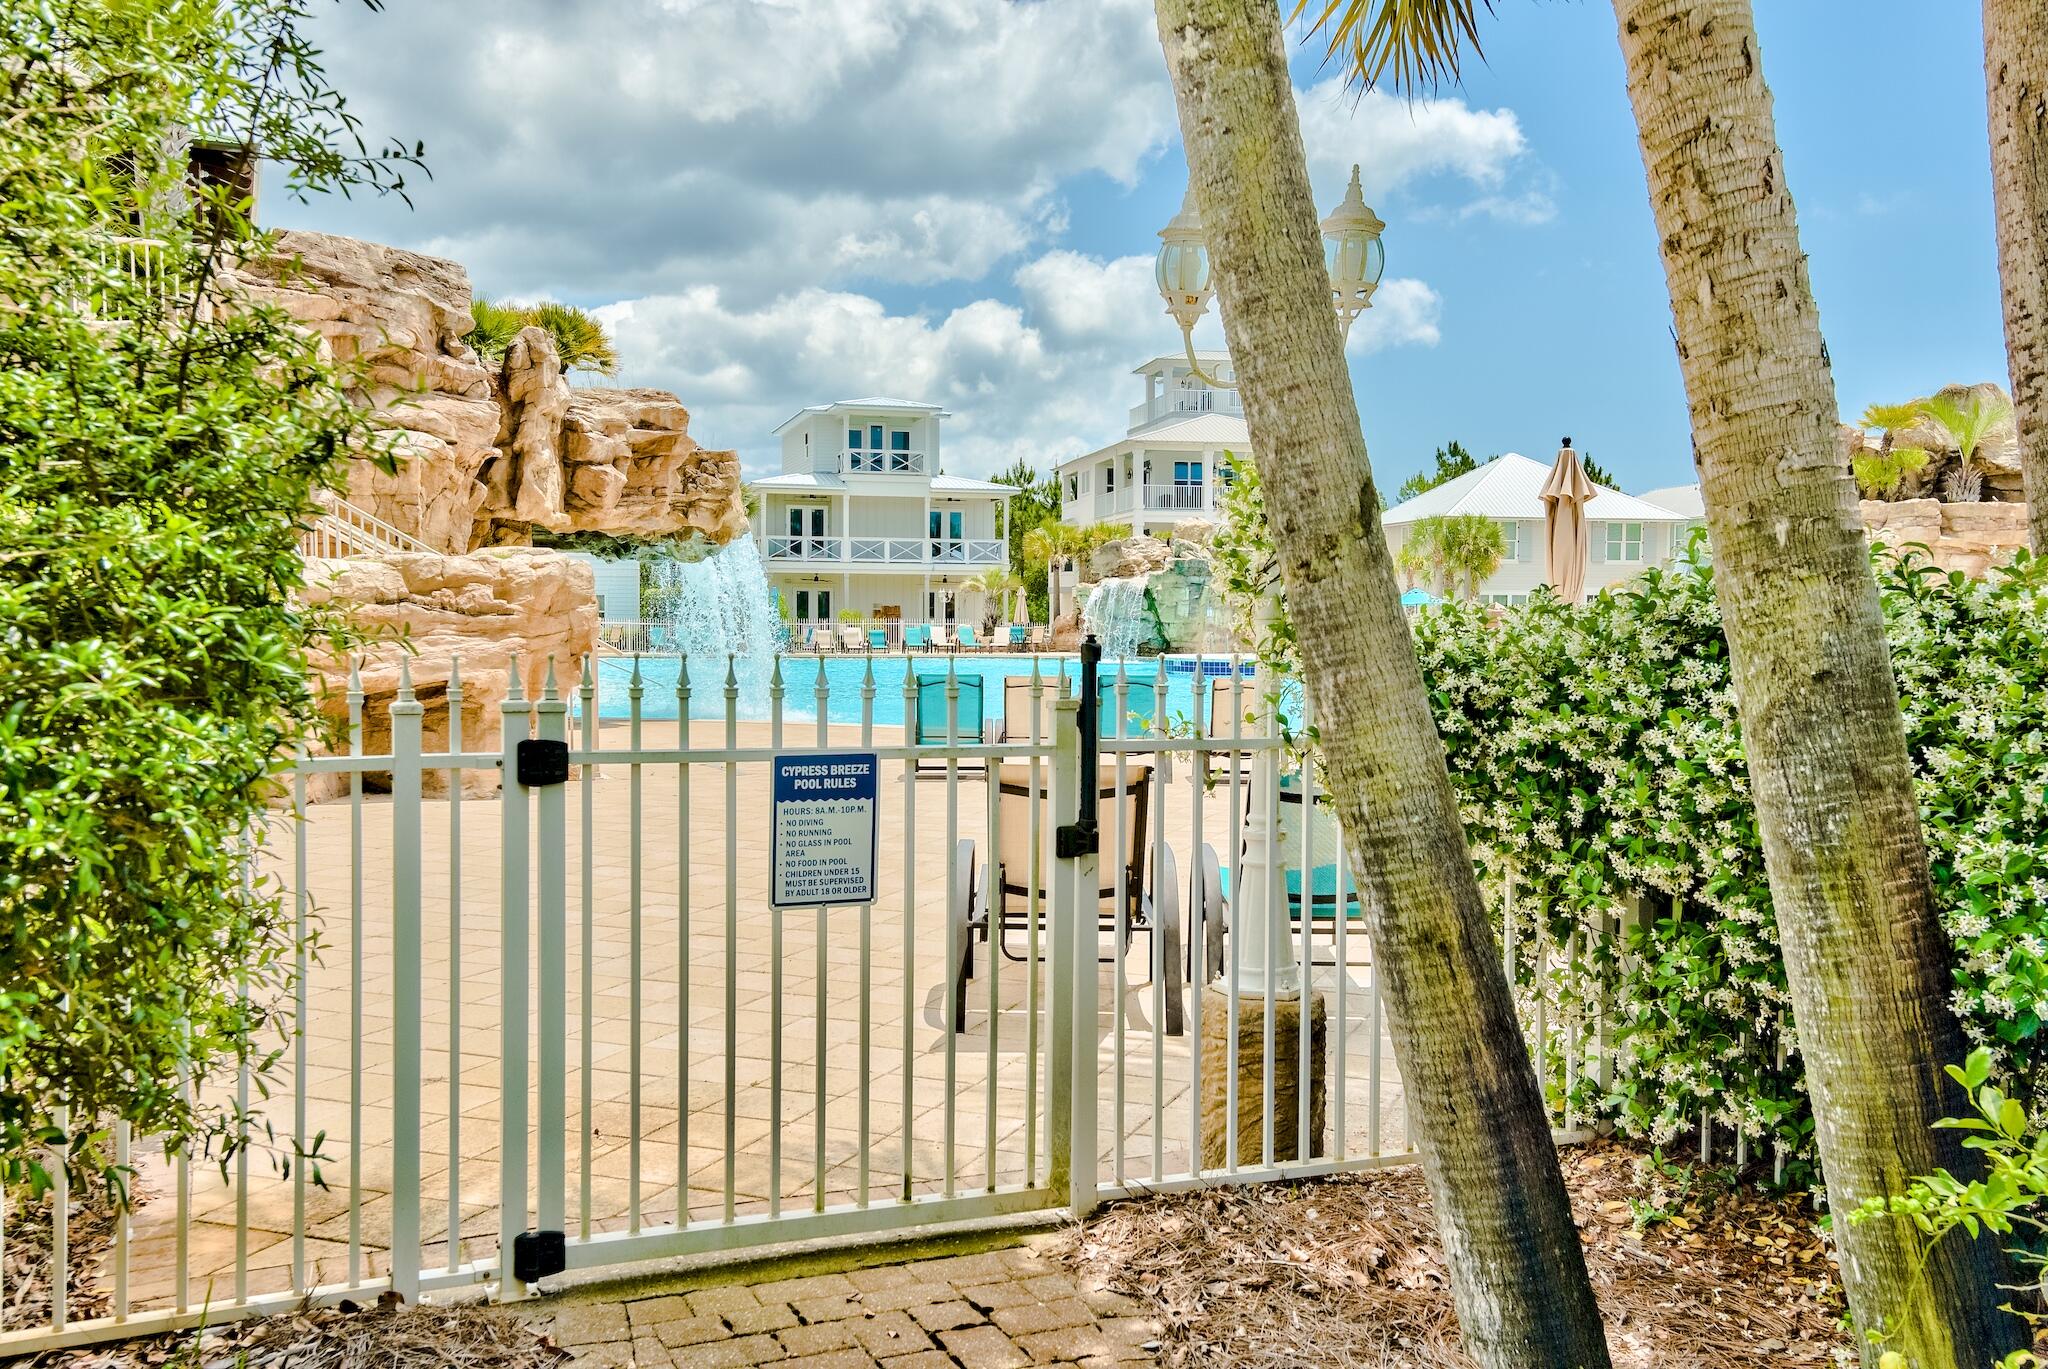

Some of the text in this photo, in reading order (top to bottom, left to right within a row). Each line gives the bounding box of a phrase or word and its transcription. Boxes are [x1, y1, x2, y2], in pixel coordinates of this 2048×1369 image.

[782, 764, 870, 776] CYPRESS BREEZE
[794, 778, 856, 790] POOL RULES
[798, 818, 824, 826] DIVING
[798, 828, 832, 836] RUNNING
[834, 838, 852, 846] POOL
[828, 858, 848, 866] POOL
[786, 870, 822, 878] CHILDREN
[824, 868, 849, 876] UNDER
[820, 876, 864, 886] SUPERVISED
[844, 886, 866, 894] OLDER
